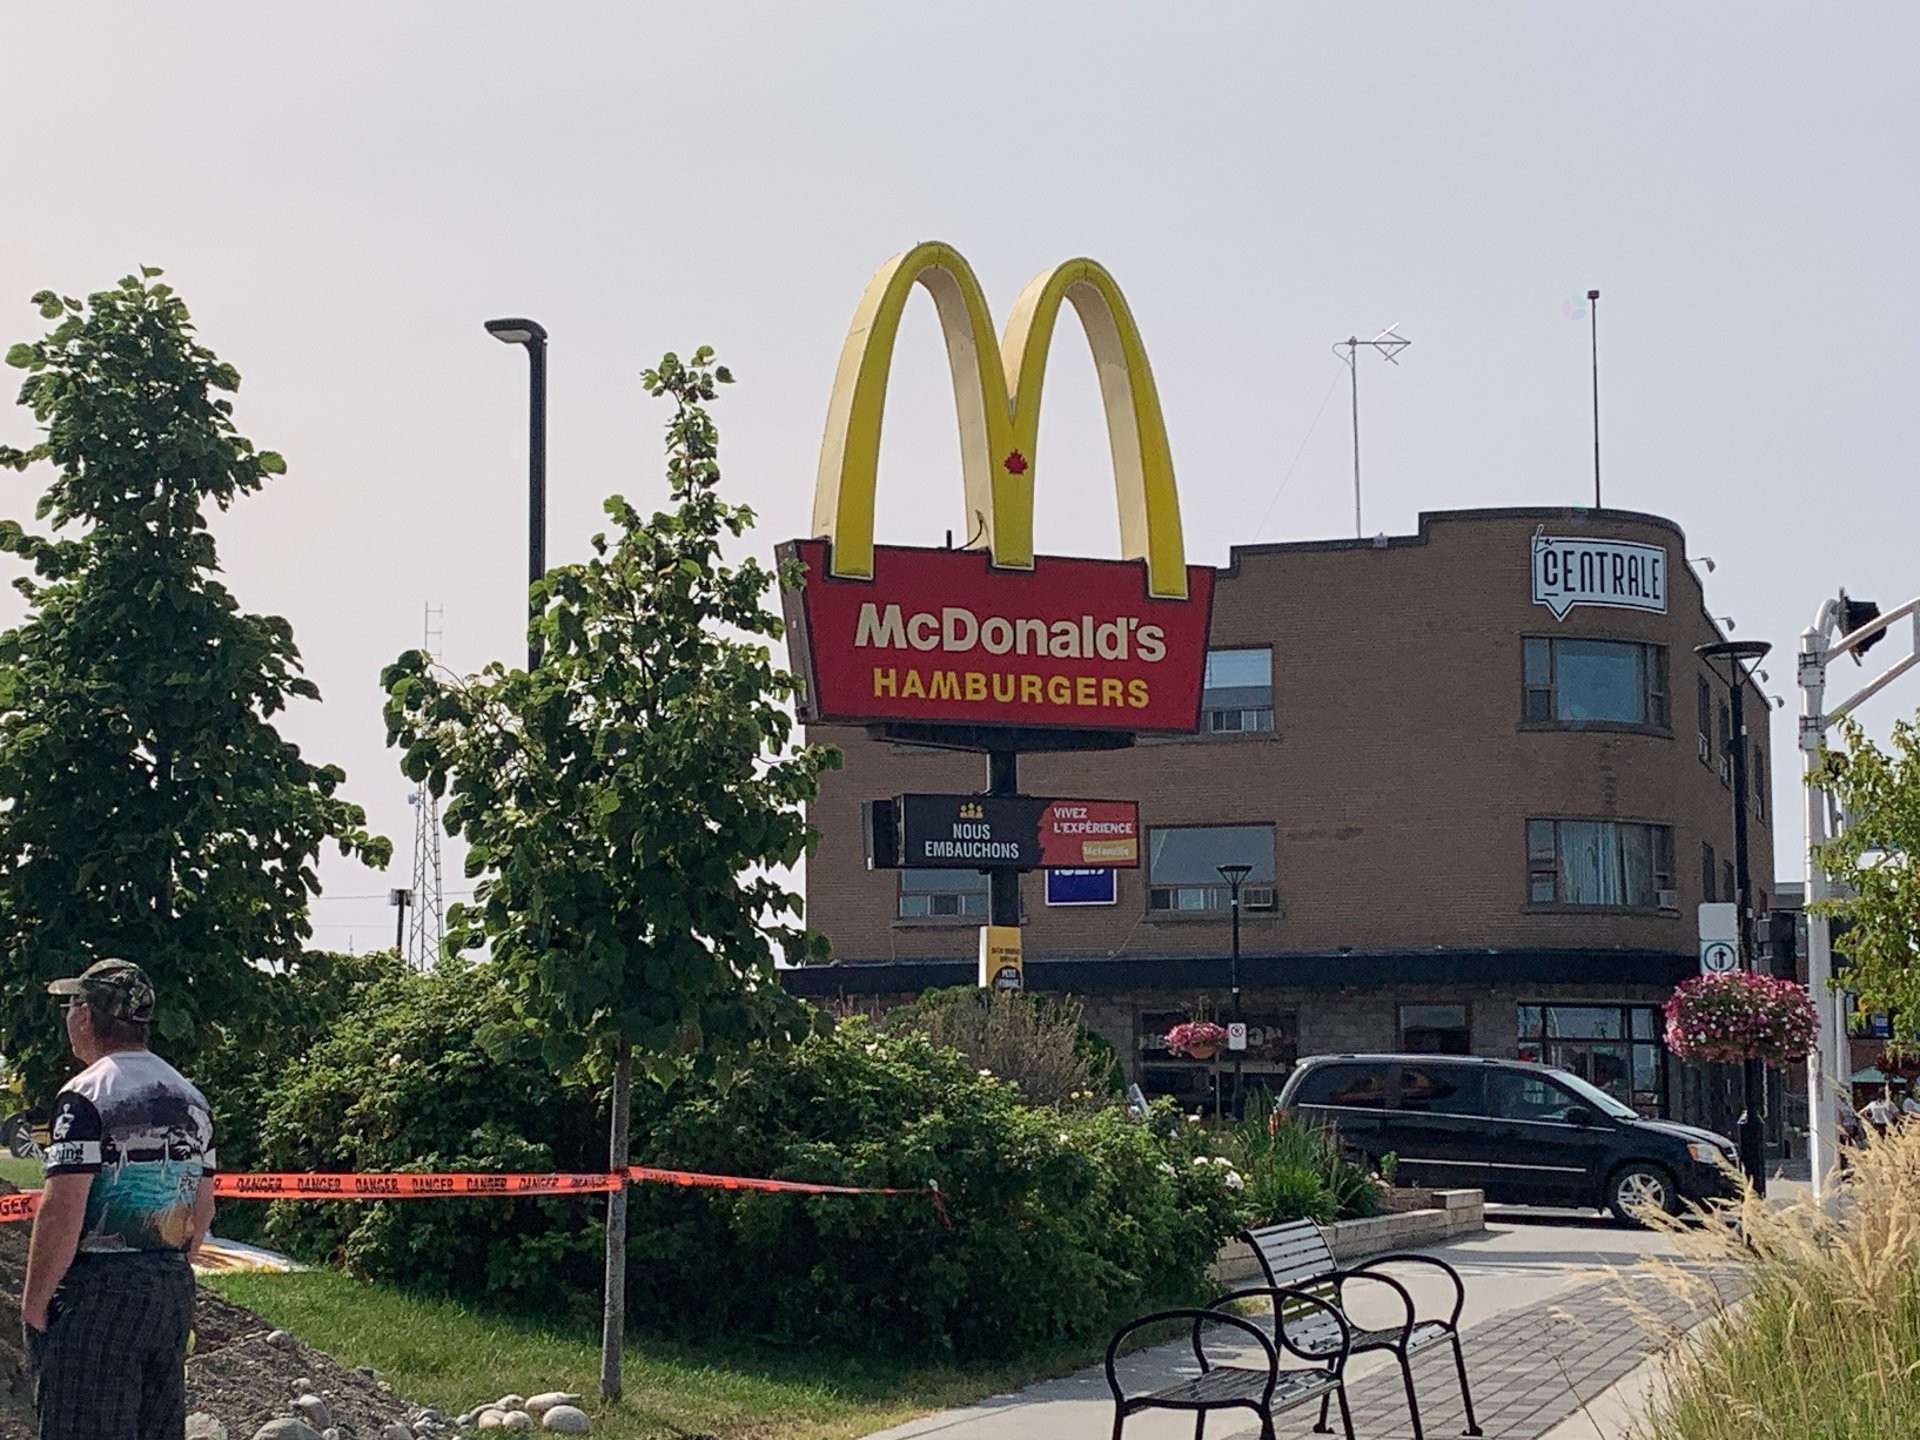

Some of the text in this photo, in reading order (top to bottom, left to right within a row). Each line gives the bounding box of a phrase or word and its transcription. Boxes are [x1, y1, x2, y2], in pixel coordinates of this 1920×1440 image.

[1543, 550, 1661, 600] CENTRALE
[854, 602, 1167, 662] McDonald's
[873, 667, 1150, 709] HAMBURGERS
[1053, 807, 1088, 819] VIVEZ
[953, 823, 991, 841] NOUS
[925, 840, 1020, 859] EMBAUCHONS
[236, 1177, 284, 1193] DANGER
[297, 1177, 343, 1193] DANGER
[355, 1177, 400, 1194] DANGER
[411, 1177, 454, 1193] DANGER
[466, 1176, 508, 1193] DANGER
[518, 1177, 560, 1192] DANGER
